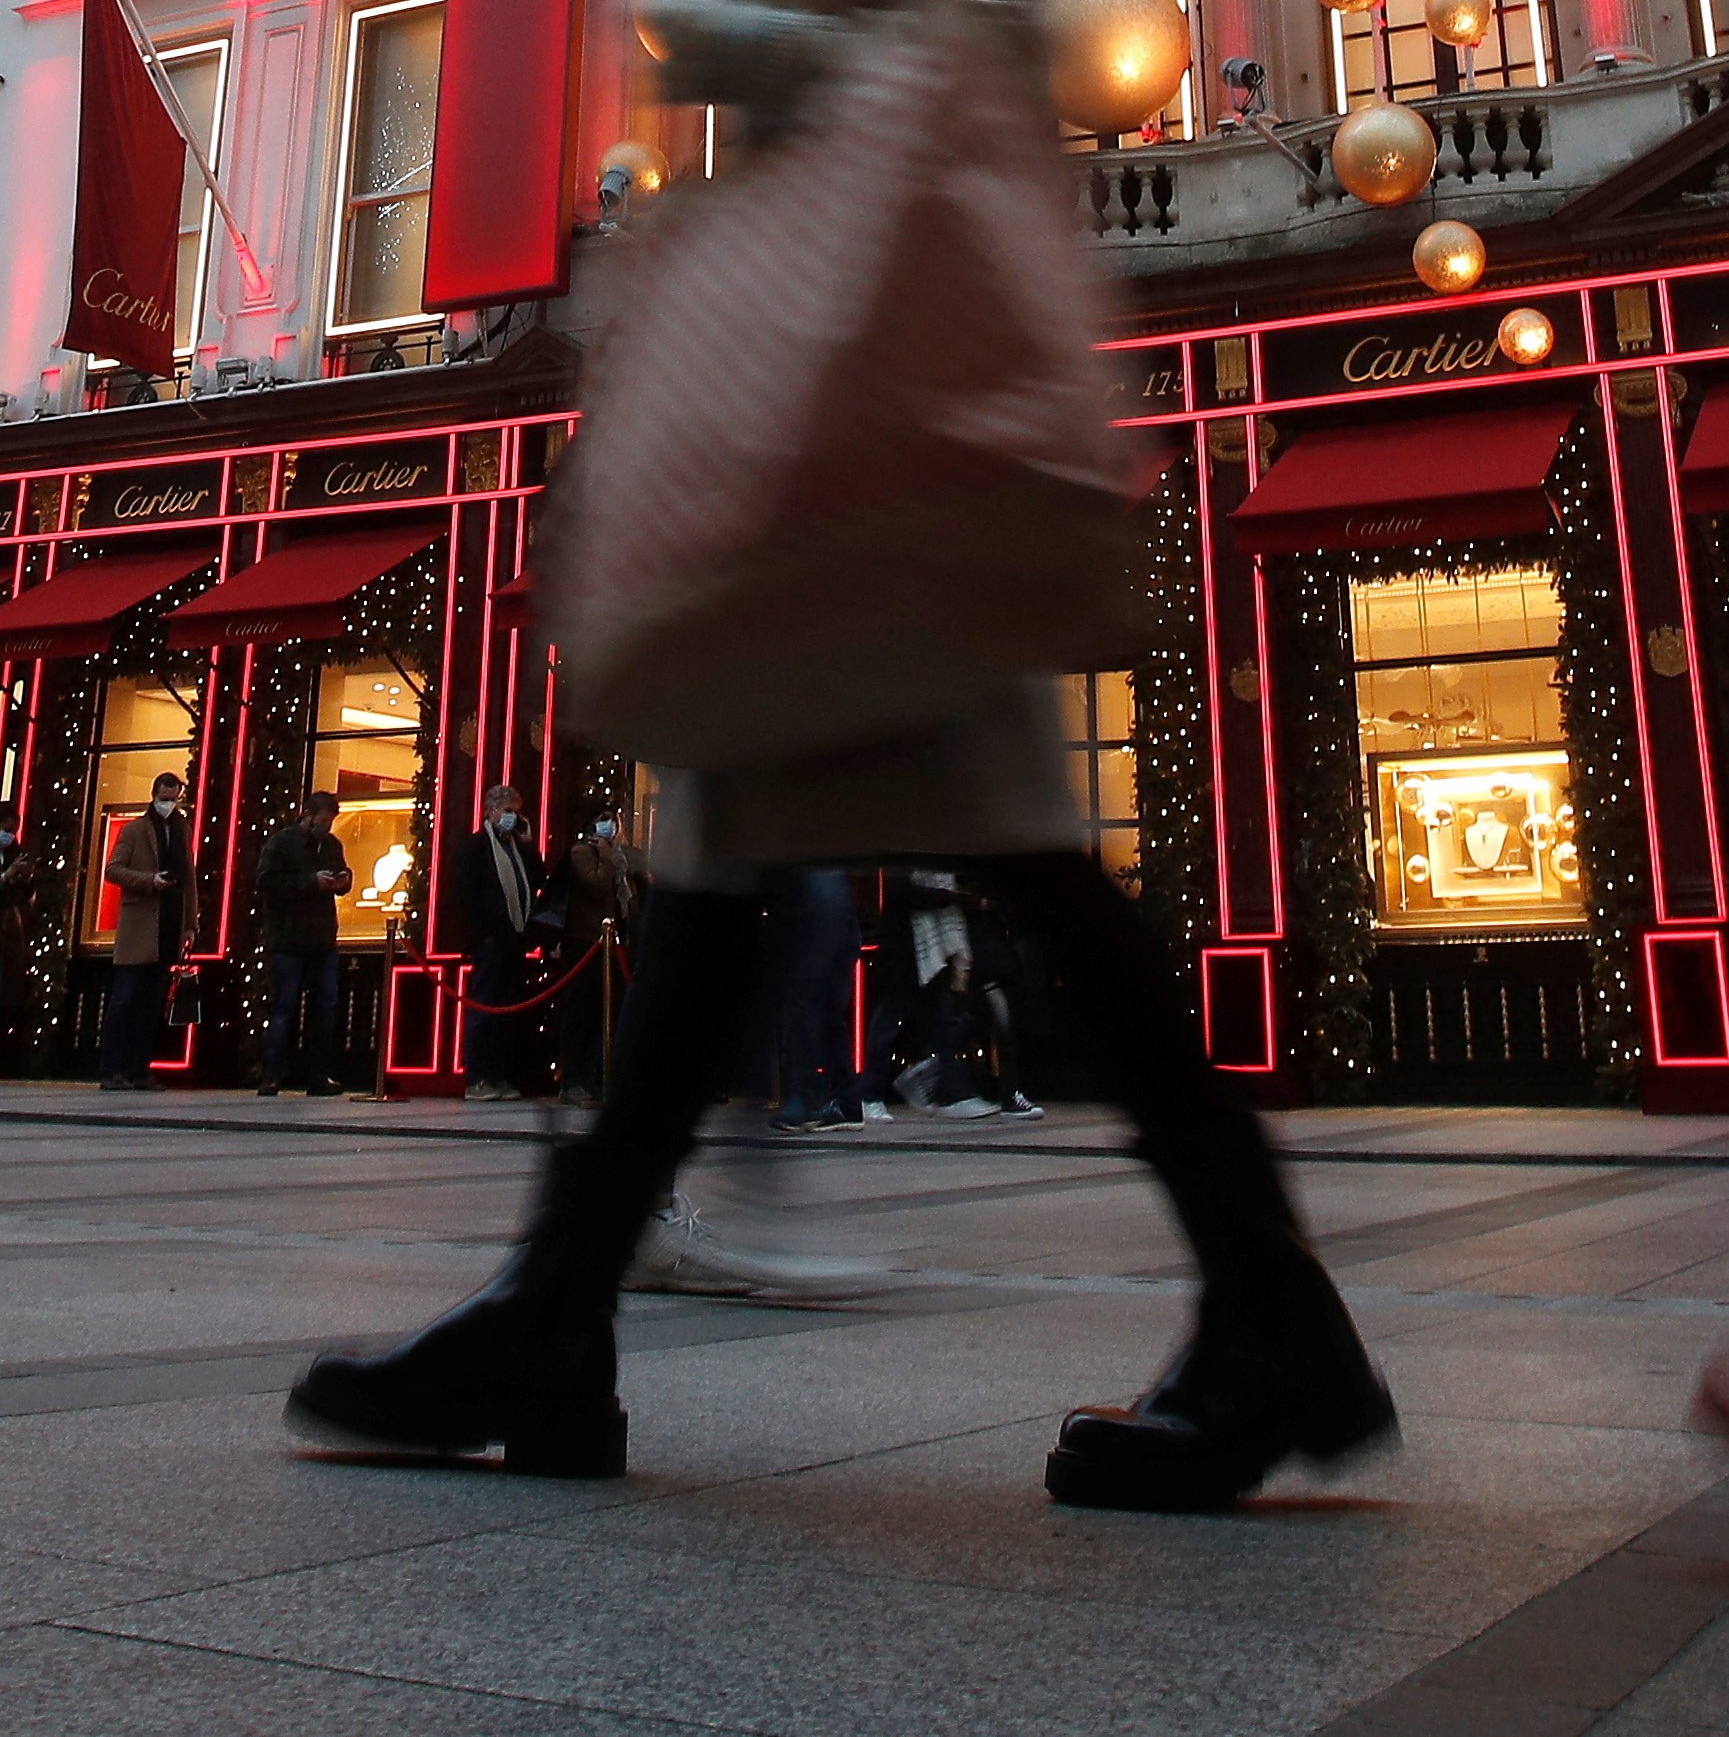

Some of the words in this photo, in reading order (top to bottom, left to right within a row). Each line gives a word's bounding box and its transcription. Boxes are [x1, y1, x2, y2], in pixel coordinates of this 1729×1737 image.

[1342, 333, 1500, 383] Cartier
[1142, 370, 1184, 396] 175
[324, 461, 429, 497] Cartier
[114, 485, 209, 519] Cartier
[1345, 516, 1424, 538] Cartier
[226, 620, 281, 637] Cartier
